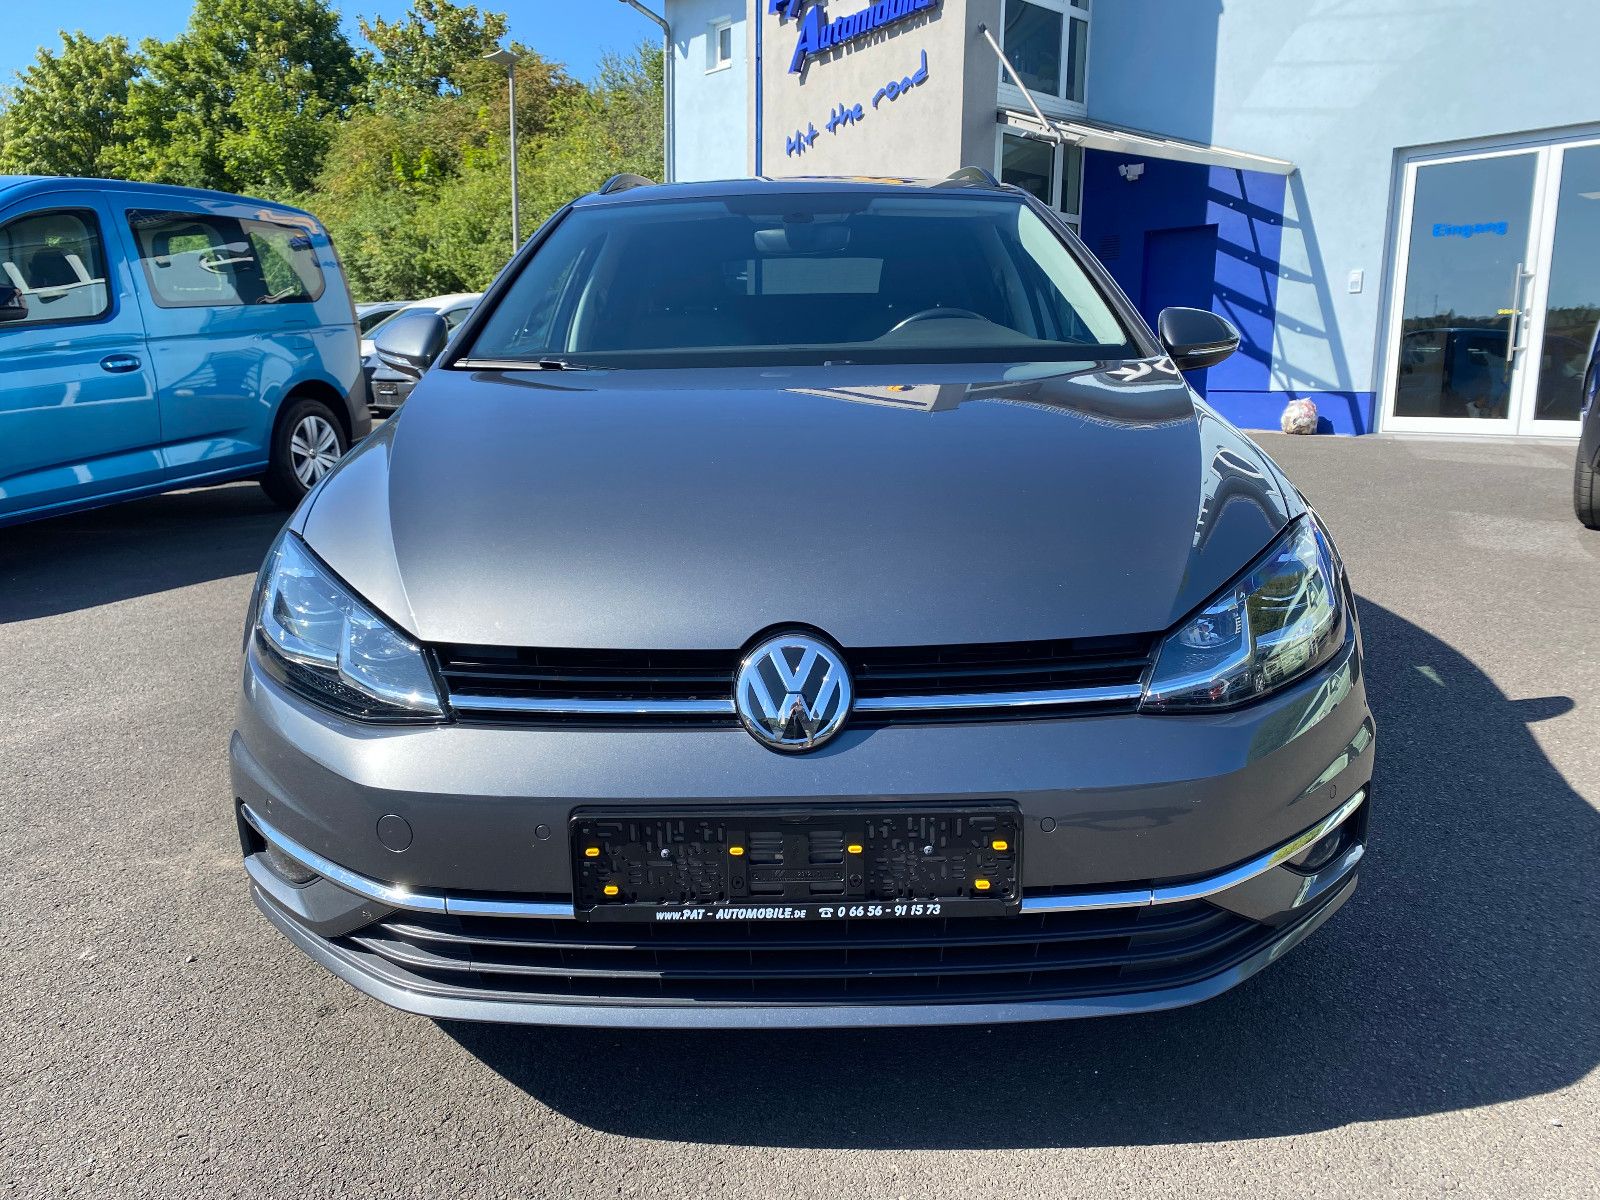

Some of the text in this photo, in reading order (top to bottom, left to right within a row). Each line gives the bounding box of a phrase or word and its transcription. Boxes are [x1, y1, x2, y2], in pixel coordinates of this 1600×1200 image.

[826, 103, 865, 135] the
[872, 49, 929, 109] road
[1432, 221, 1509, 239] Eingang
[738, 634, 851, 753] VW
[837, 906, 846, 918] 0
[848, 905, 865, 917] 66
[866, 905, 883, 917] 56
[894, 904, 908, 917] 91
[910, 904, 924, 916] 15
[926, 903, 941, 916] 73
